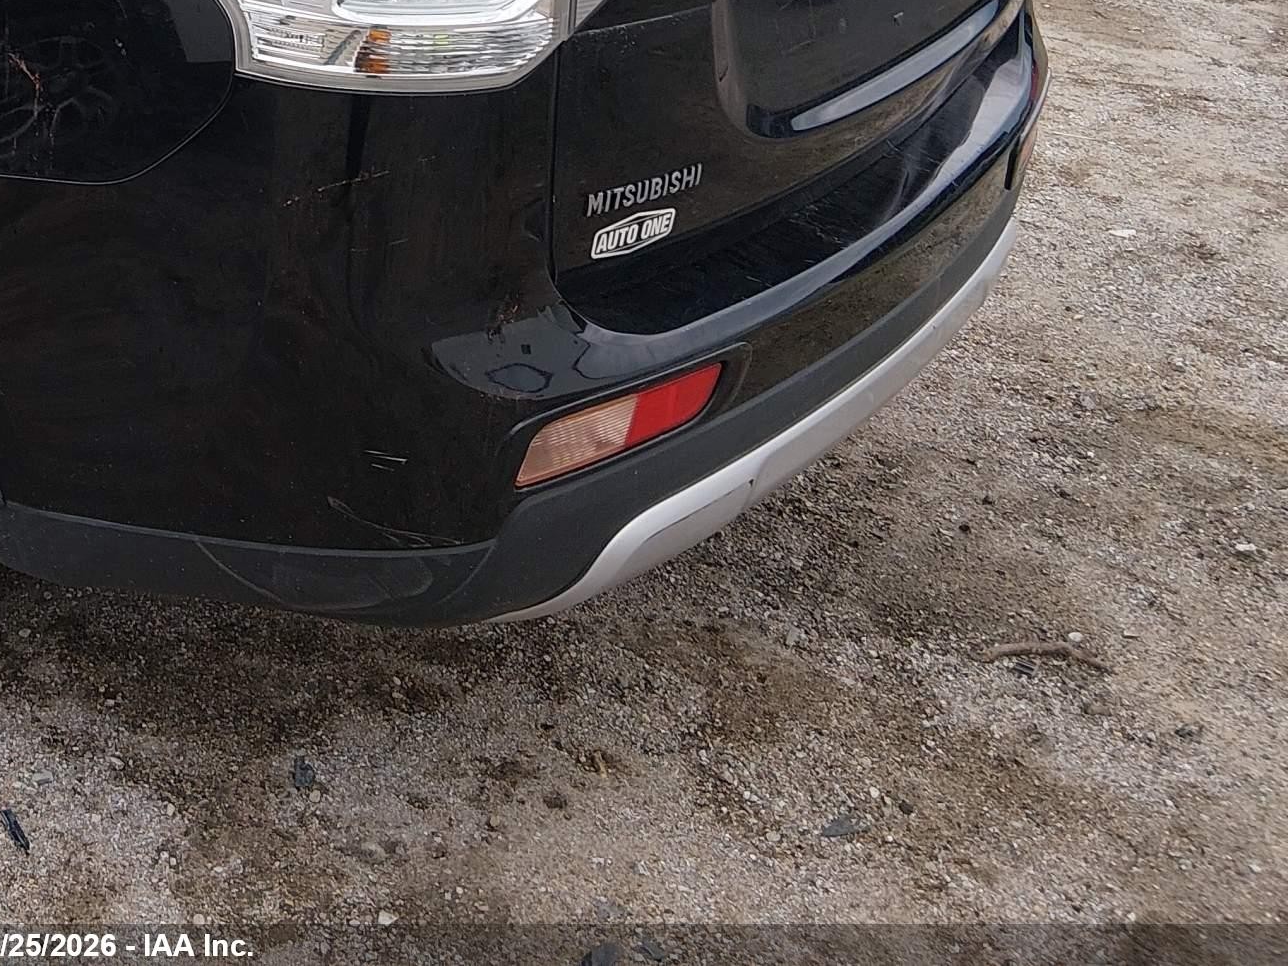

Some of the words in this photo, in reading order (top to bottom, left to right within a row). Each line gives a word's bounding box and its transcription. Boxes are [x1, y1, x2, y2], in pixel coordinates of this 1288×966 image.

[587, 162, 703, 217] MITSUBISHI
[595, 224, 639, 254] AUTO
[640, 213, 672, 240] ONE
